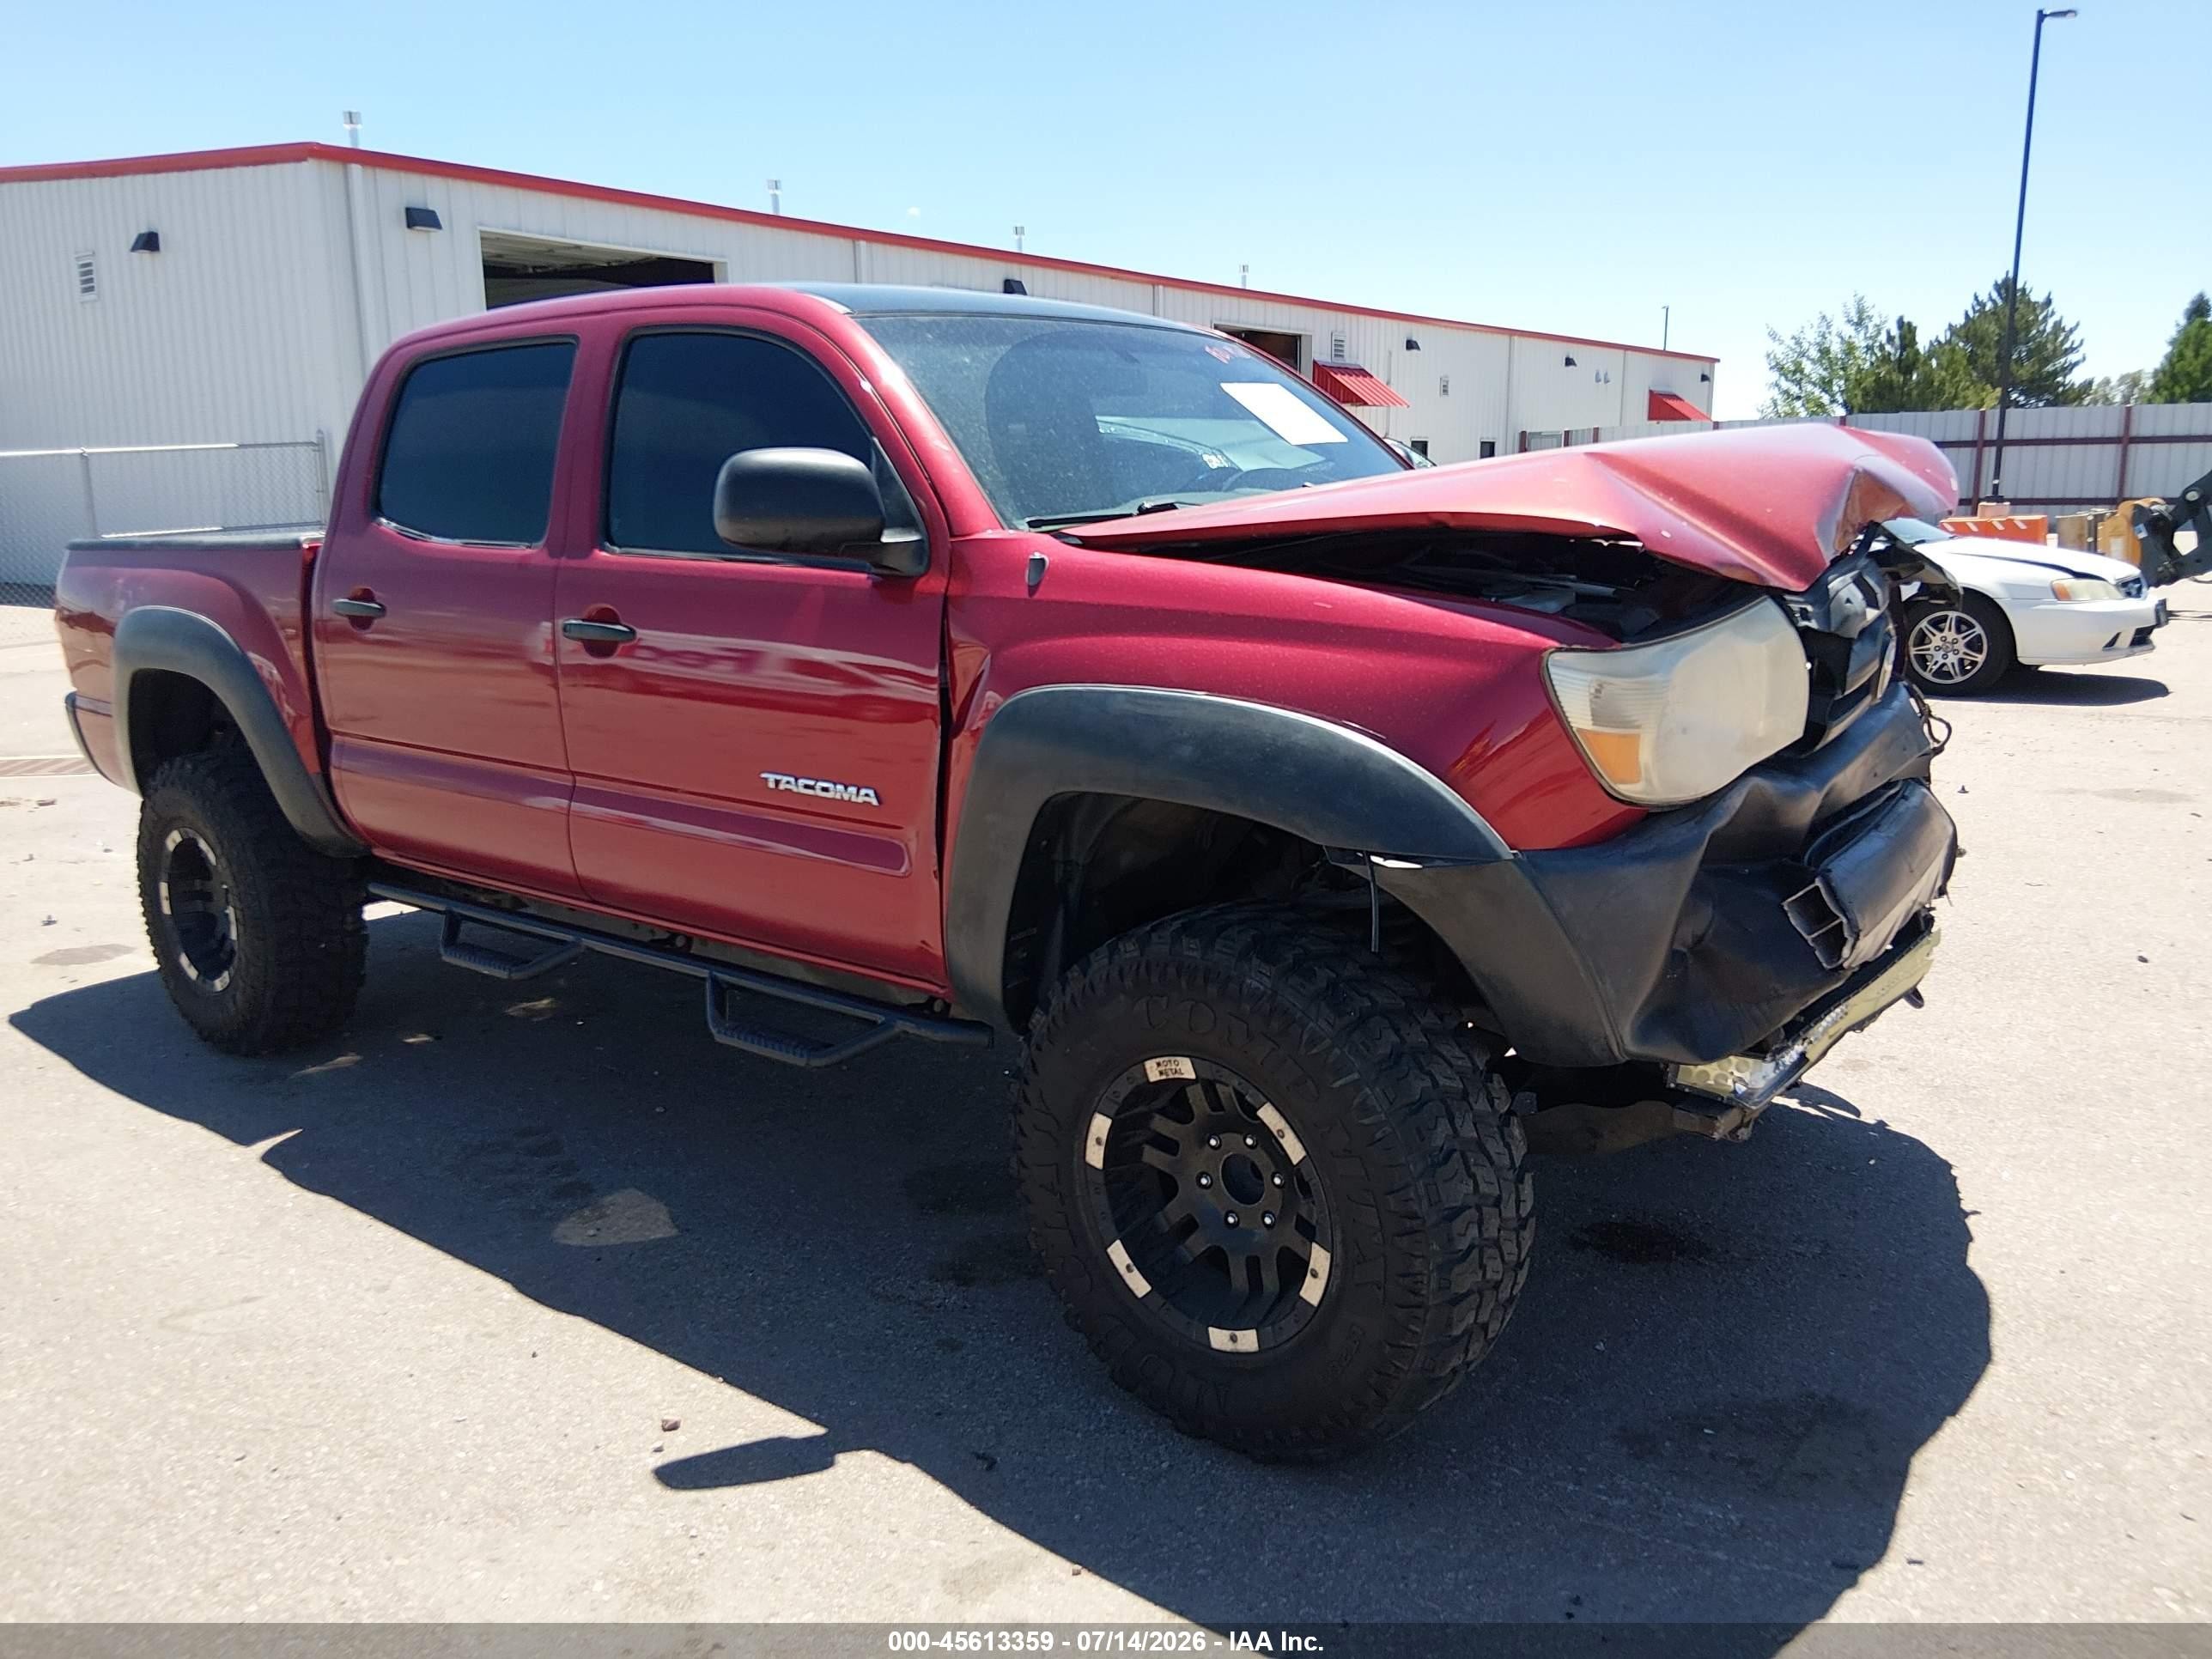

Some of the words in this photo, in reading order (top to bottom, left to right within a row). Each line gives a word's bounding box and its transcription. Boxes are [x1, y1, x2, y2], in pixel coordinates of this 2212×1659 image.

[760, 772, 879, 805] TACOMA
[1155, 1059, 1180, 1068] MOTO
[1158, 1067, 1184, 1077] METAL
